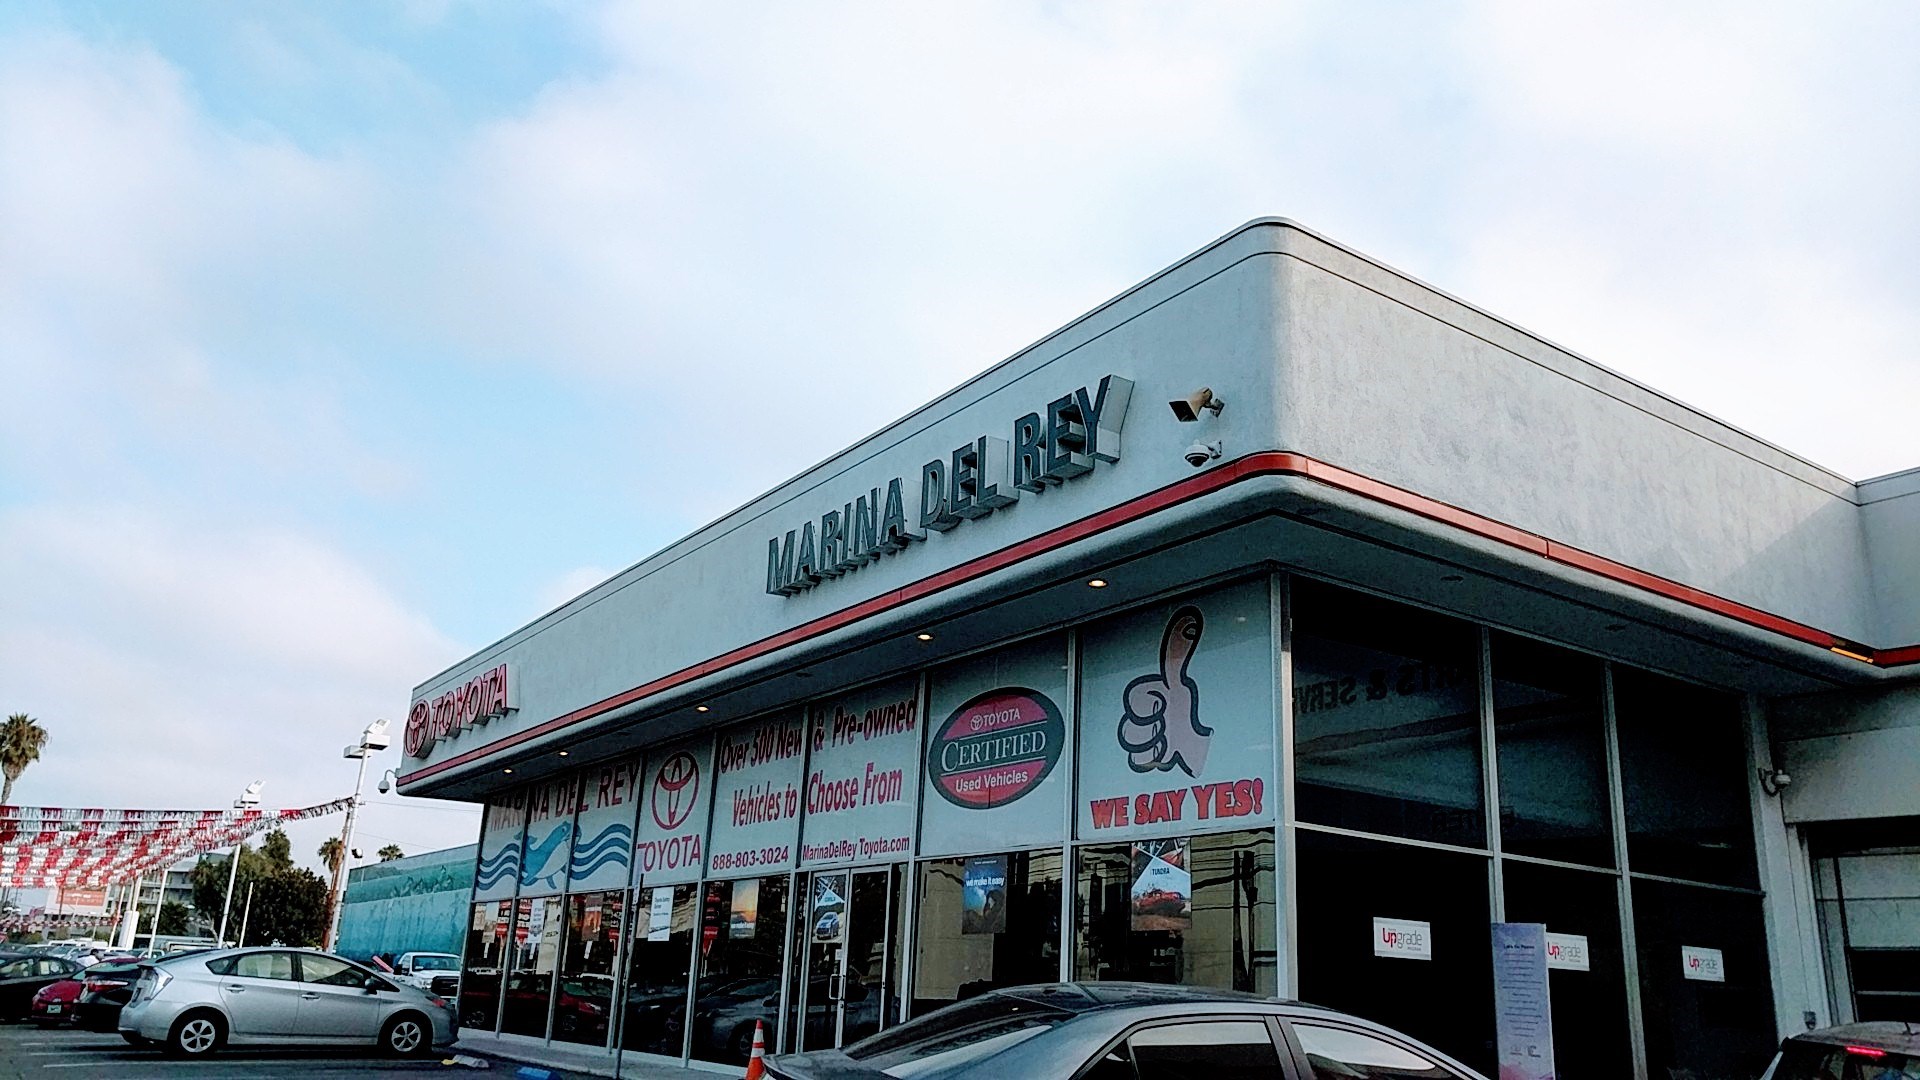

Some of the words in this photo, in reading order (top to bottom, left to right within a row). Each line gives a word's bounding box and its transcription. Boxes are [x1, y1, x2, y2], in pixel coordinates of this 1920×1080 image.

[766, 477, 906, 595] MARINA
[920, 435, 1000, 528] DEL
[1013, 374, 1112, 487] REY
[430, 663, 507, 741] TOYOTA
[984, 708, 1020, 727] TOYOTA
[720, 737, 749, 773] Over
[751, 728, 773, 766] 500
[813, 711, 824, 752] &
[832, 699, 917, 748] Pre-owned
[941, 730, 1046, 772] CERTIFIED
[597, 762, 640, 809] REY
[732, 781, 780, 827] Vehicles
[783, 784, 797, 818] to
[807, 769, 859, 816] Choose
[862, 762, 903, 806] From
[956, 776, 981, 793] Used
[984, 770, 1028, 789] Vehicles
[1090, 795, 1129, 830] WE
[1134, 788, 1187, 825] SAY
[1191, 778, 1264, 820] YES!
[637, 834, 702, 873] TOYOTA
[712, 846, 789, 870] 888-803-3024
[802, 840, 858, 862] MarinaDelRey
[859, 835, 910, 857] Toyota.com
[1152, 868, 1170, 876] TUNDRA
